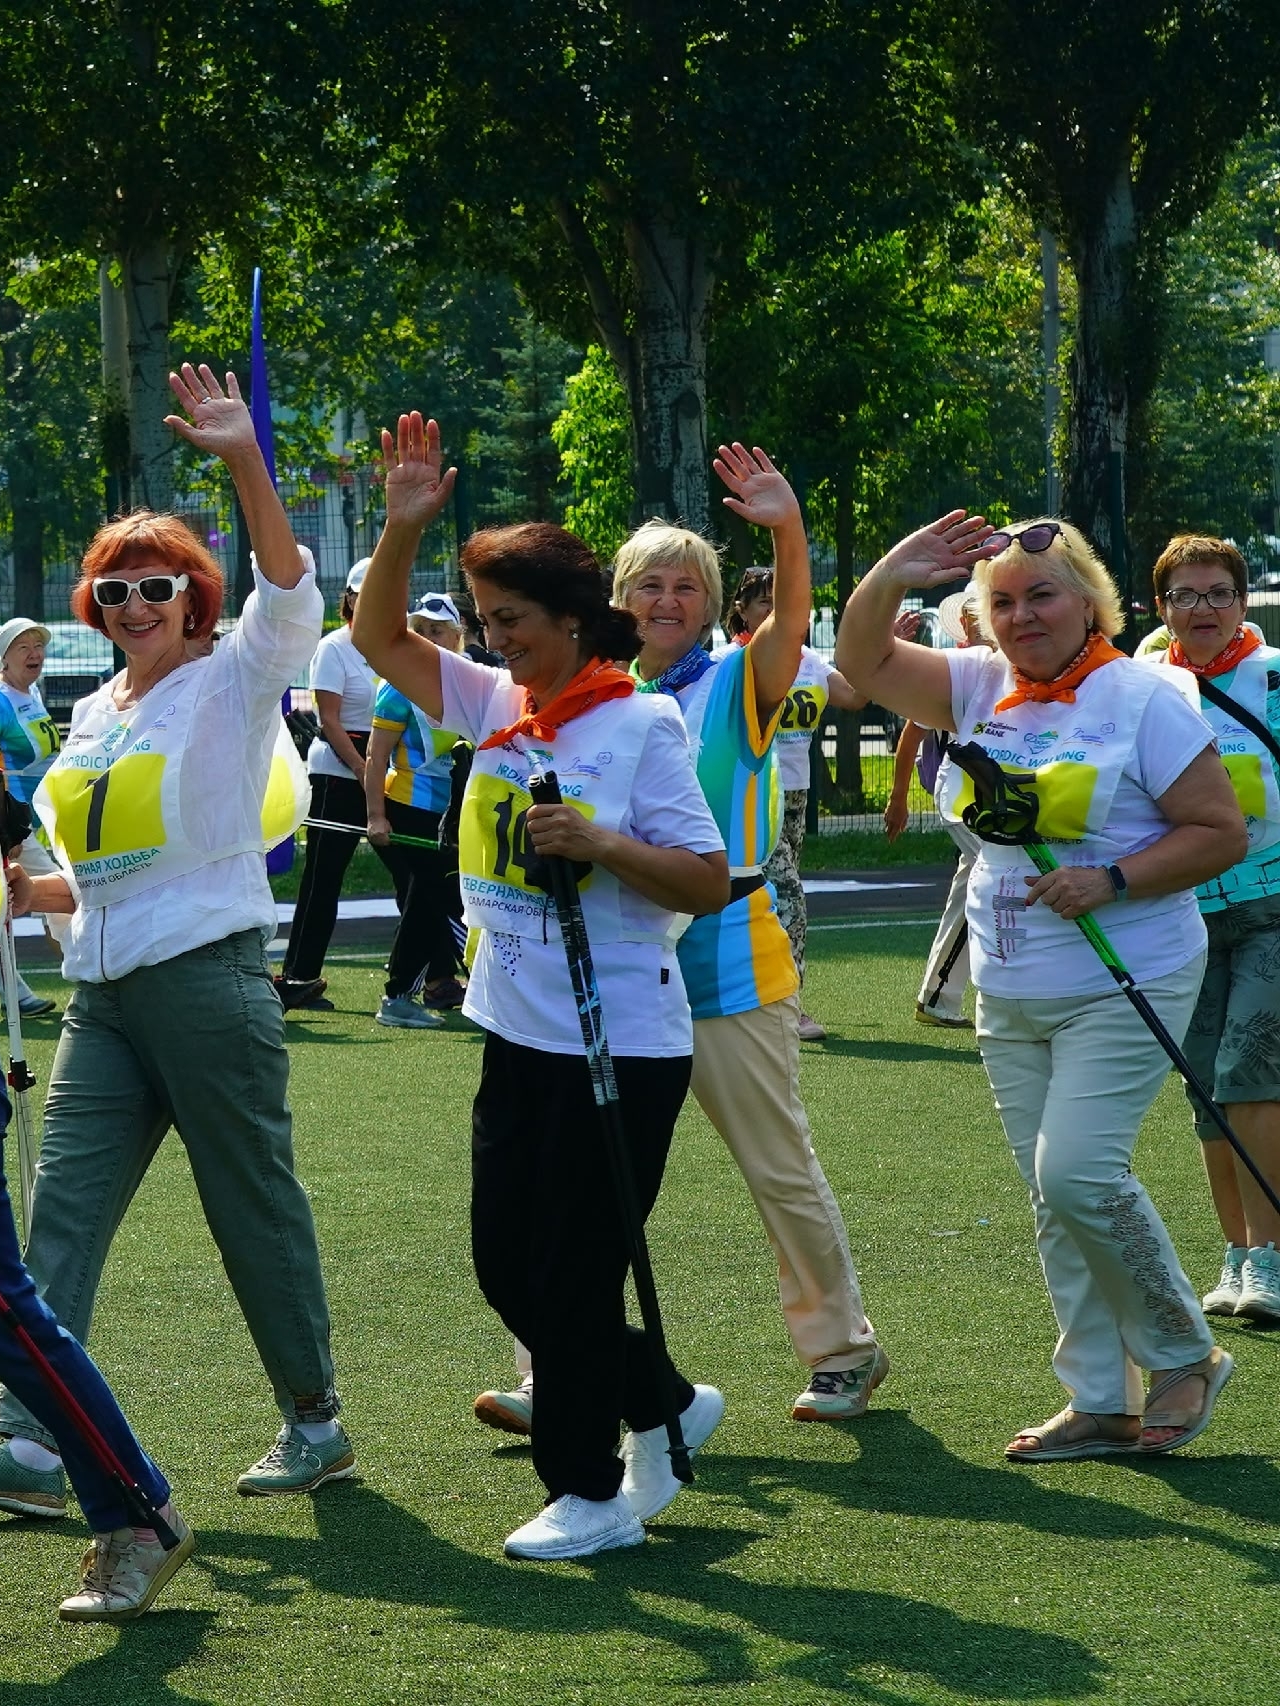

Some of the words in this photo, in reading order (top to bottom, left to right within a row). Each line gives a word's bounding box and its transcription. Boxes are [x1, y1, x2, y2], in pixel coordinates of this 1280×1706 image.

[780, 690, 818, 728] 26
[85, 770, 110, 853] 1
[103, 848, 162, 872] ХОДЬБА
[108, 862, 152, 883] ОБЛАСТЬ
[468, 895, 525, 914] САМАРСКАЯ
